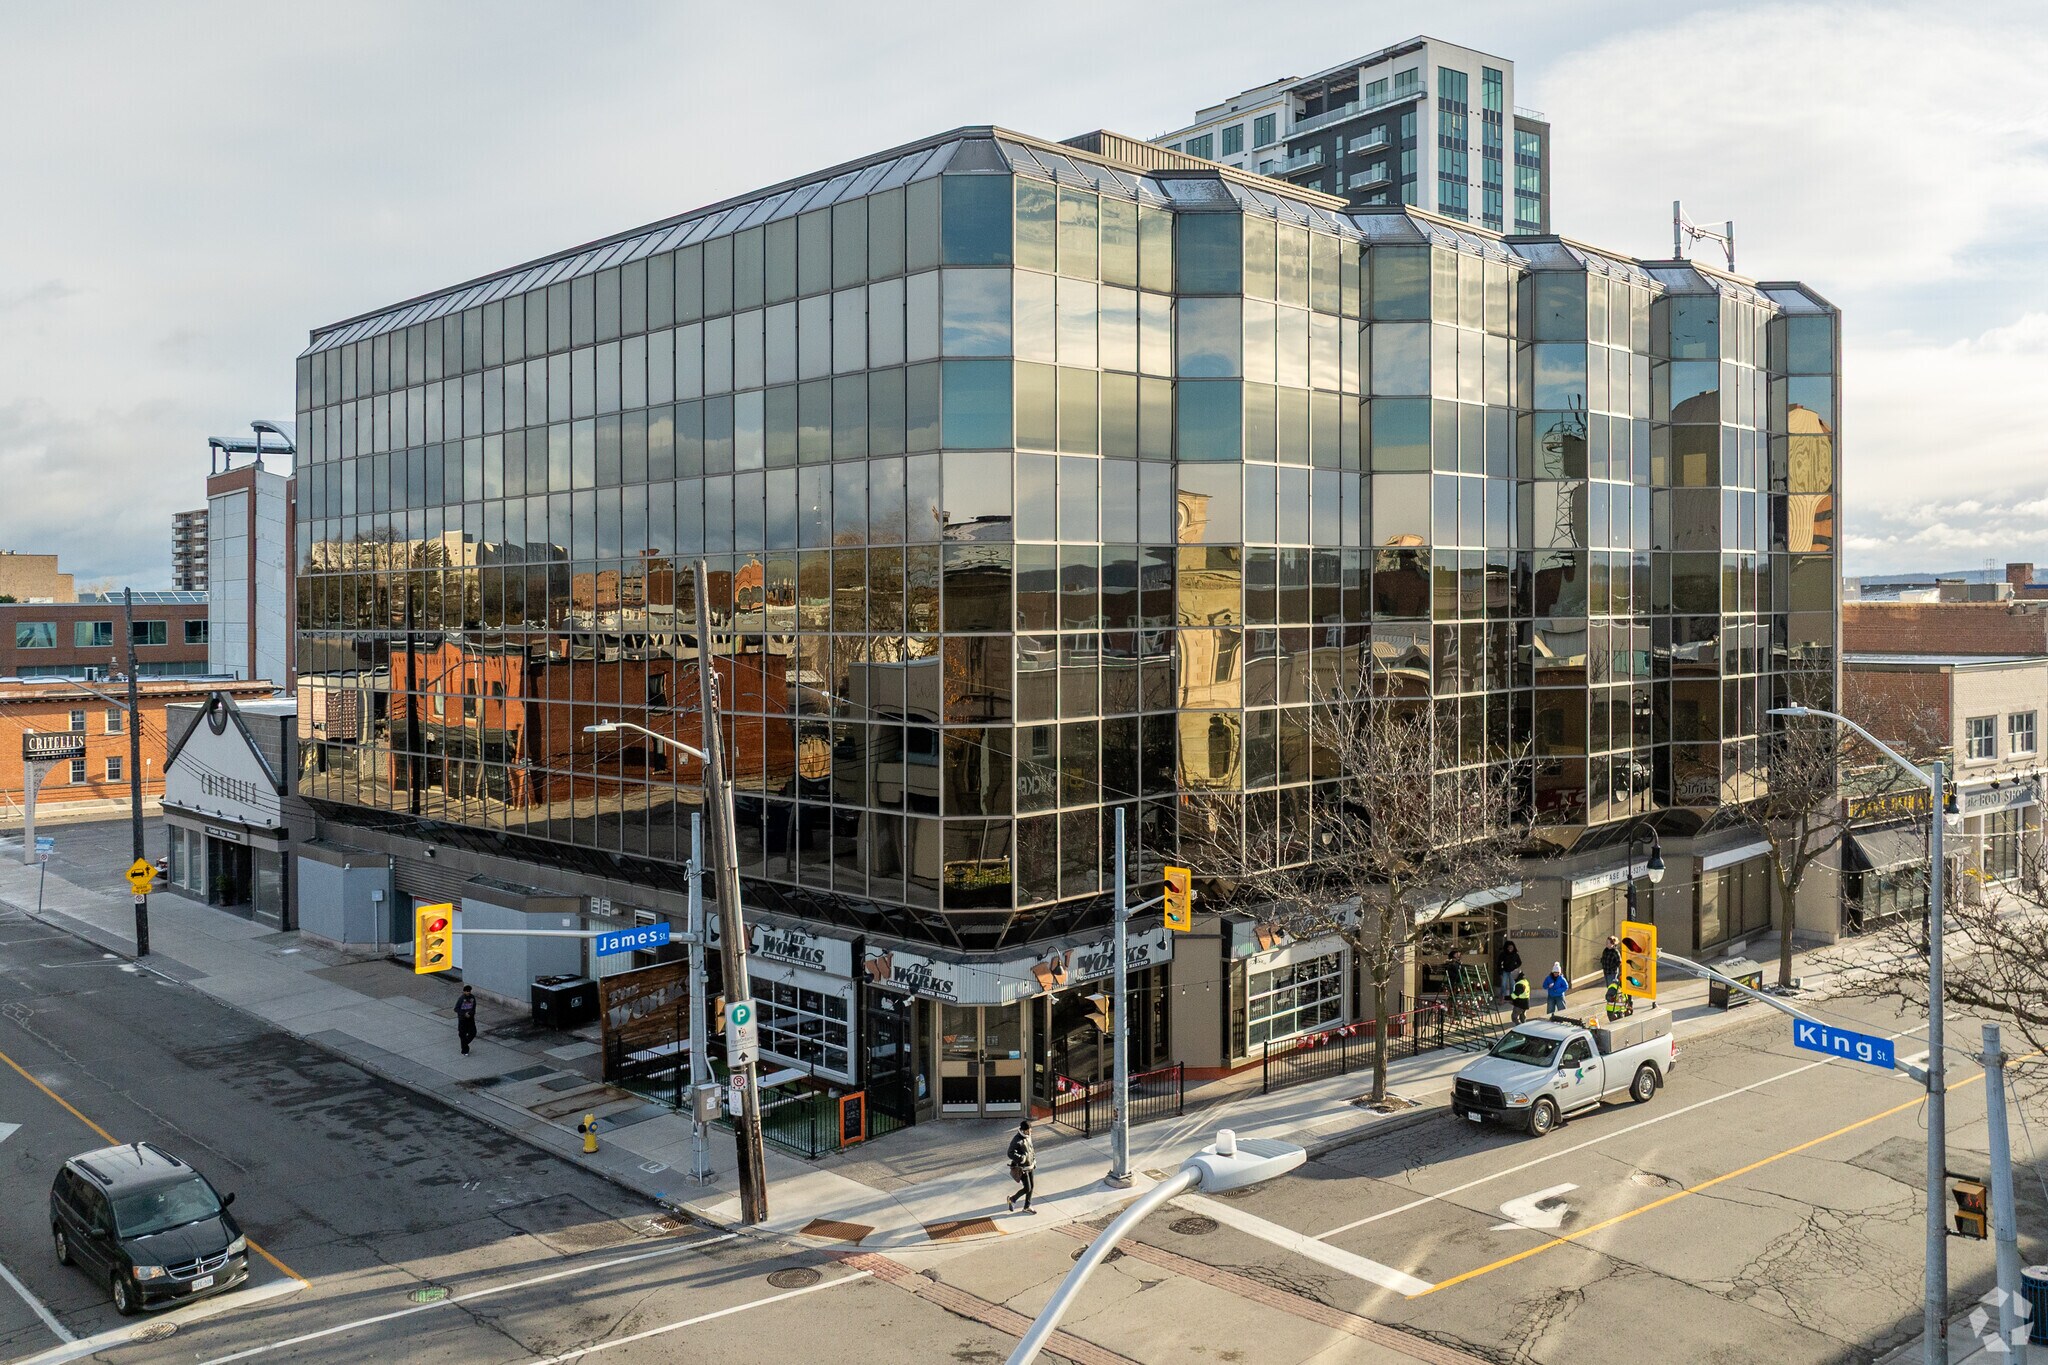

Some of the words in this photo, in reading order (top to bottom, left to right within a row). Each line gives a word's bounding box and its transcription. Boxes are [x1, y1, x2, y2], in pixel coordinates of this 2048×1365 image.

[28, 735, 84, 750] CRITELLI'S
[600, 931, 657, 951] James
[659, 933, 667, 941] St.
[783, 930, 806, 945] THE
[763, 935, 824, 963] WORKS
[894, 966, 953, 993] WORKS
[737, 1009, 746, 1022] P
[1800, 1024, 1873, 1062] King
[1877, 1050, 1888, 1062] St.
